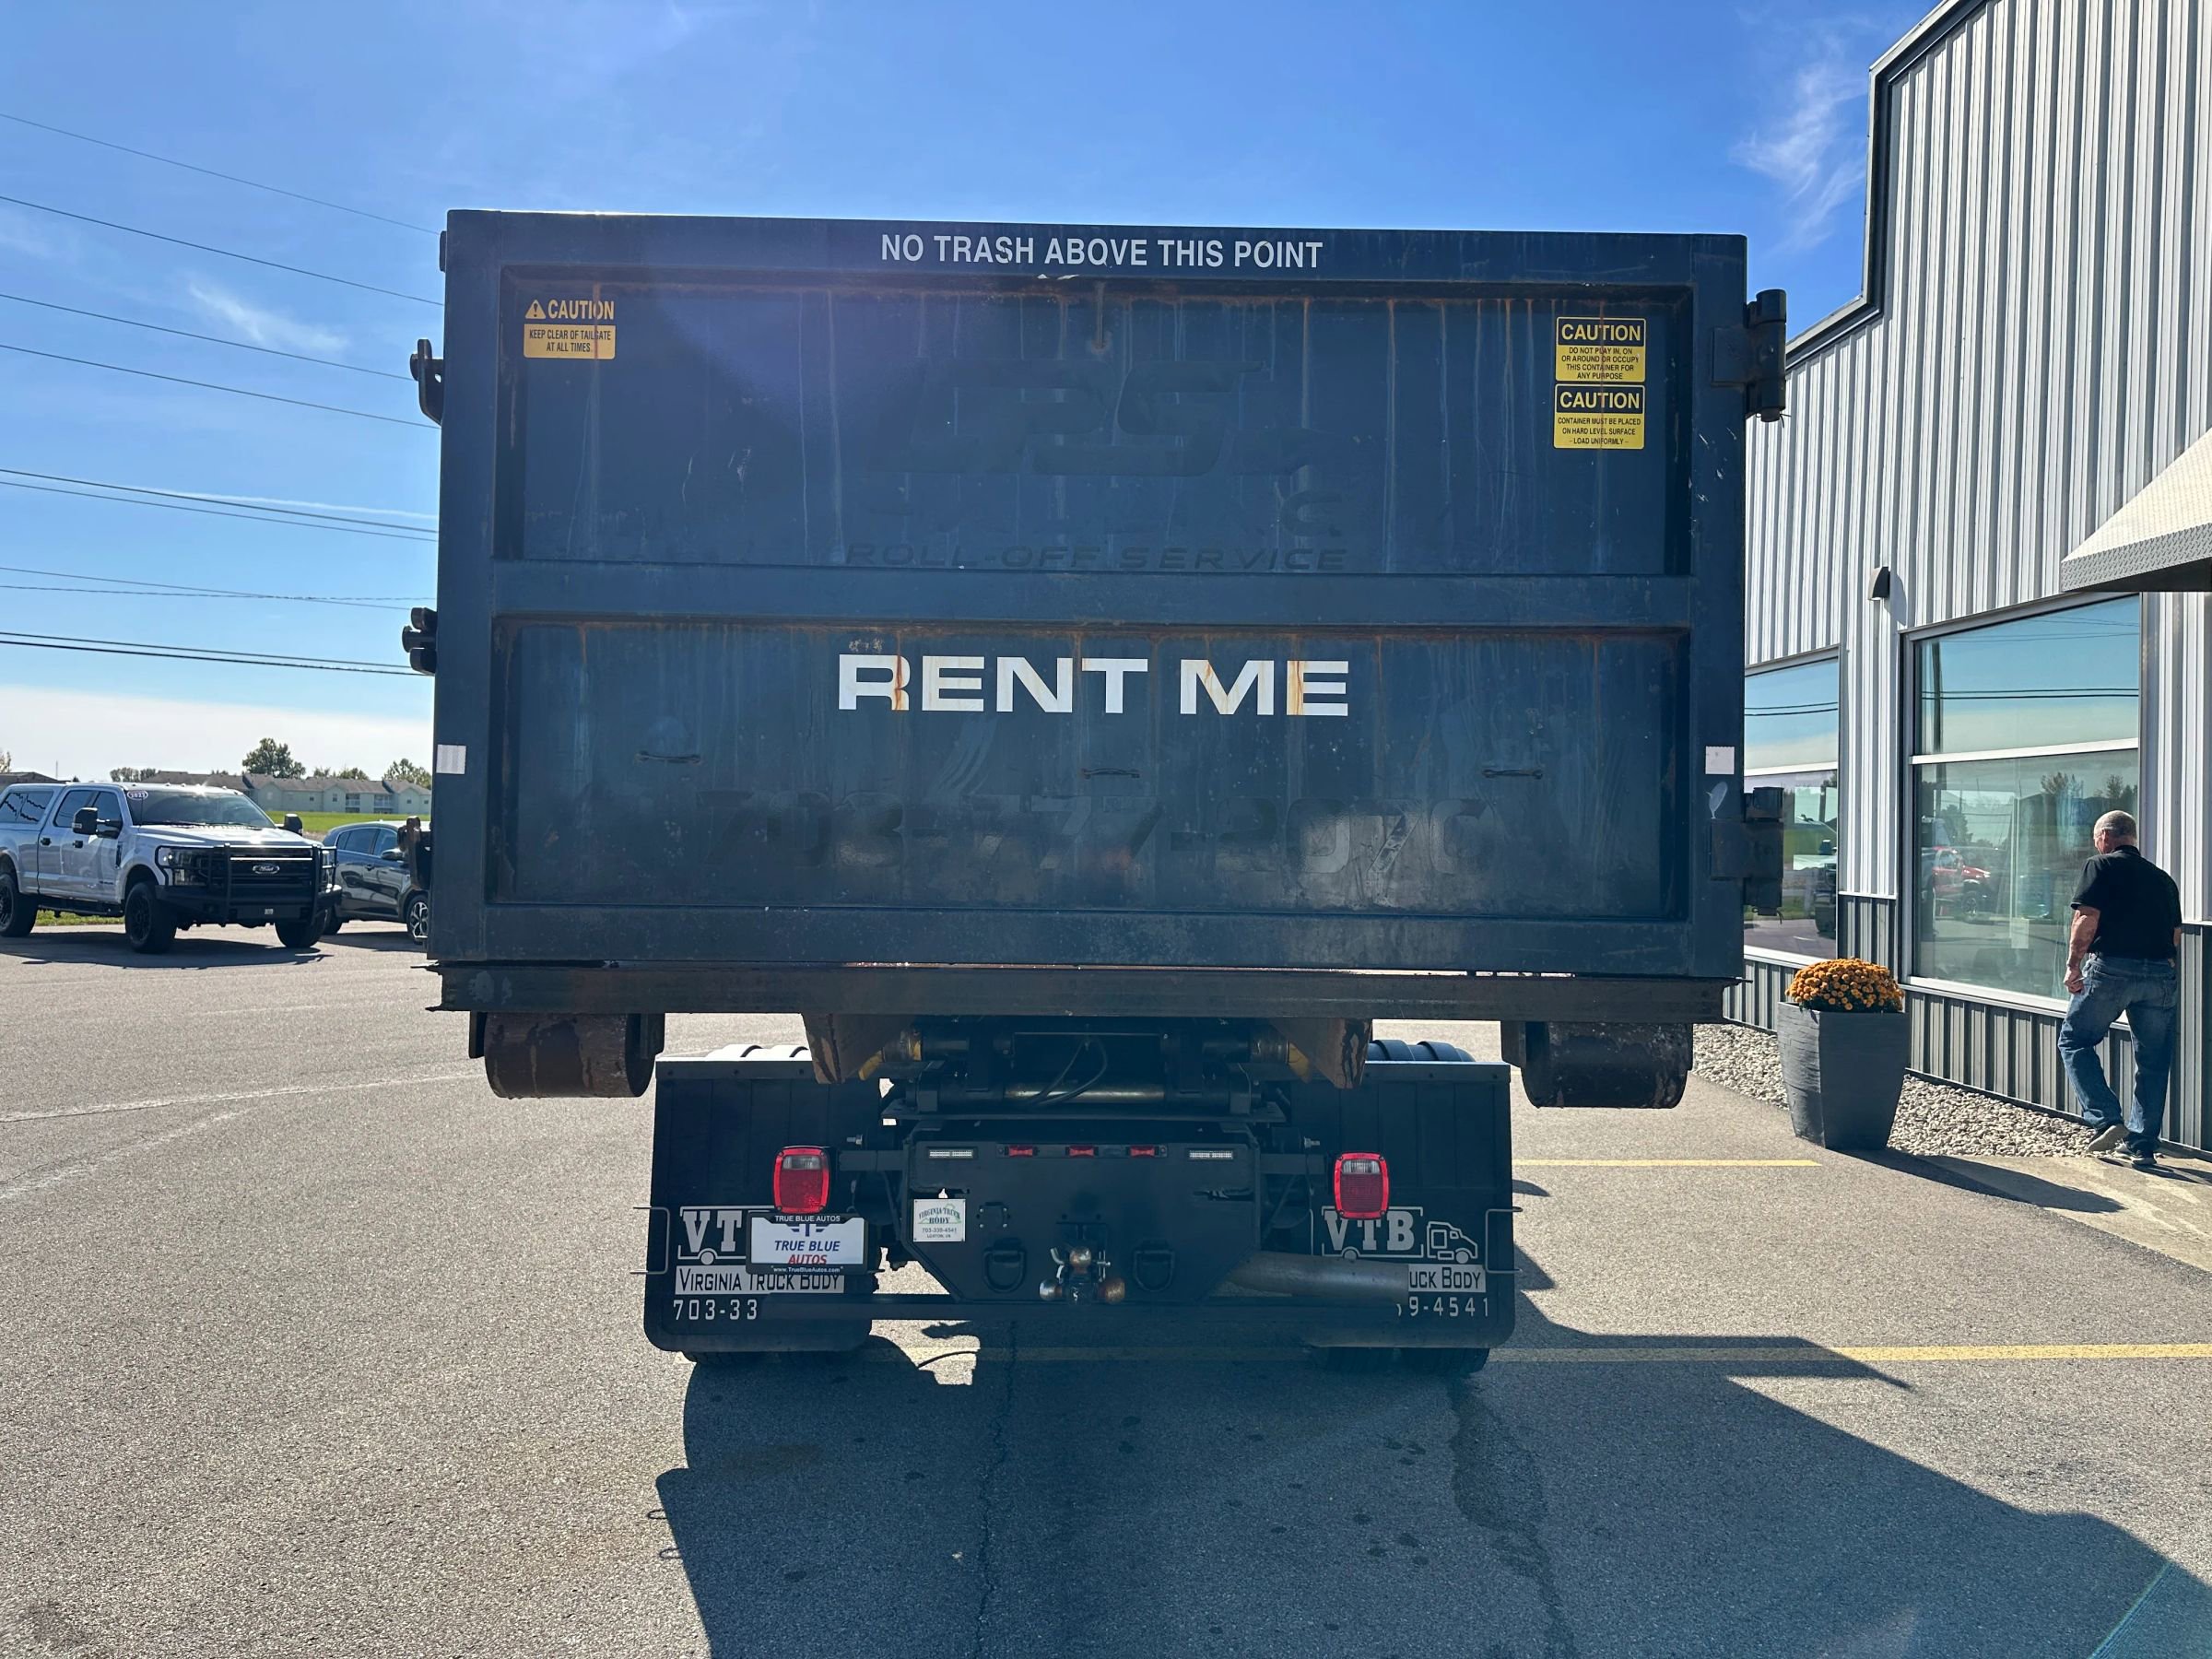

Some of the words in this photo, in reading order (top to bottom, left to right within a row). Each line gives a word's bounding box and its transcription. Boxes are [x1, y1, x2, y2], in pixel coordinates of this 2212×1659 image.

[881, 234, 924, 262] NO
[934, 235, 1034, 265] TRASH
[1044, 237, 1148, 266] ABOVE
[1156, 239, 1224, 267] THIS
[1233, 241, 1324, 269] POINT
[547, 300, 615, 320] CAUTION
[529, 330, 546, 339] KEEP
[547, 330, 569, 340] CLEAR
[570, 331, 580, 340] OF
[581, 331, 611, 340] TAILGATE
[1561, 324, 1641, 341] CAUTION
[546, 342, 555, 351] AT
[556, 342, 569, 352] ALL
[1559, 391, 1640, 409] CAUTION
[1572, 427, 1589, 435] HARD
[1573, 436, 1590, 444] LOAD
[1591, 437, 1624, 445] UNIFORMLY
[845, 542, 1101, 569] ROLL-OFF
[1119, 546, 1347, 571] SERVICE
[838, 653, 1149, 715] RENT
[1180, 659, 1349, 717] ME
[775, 1215, 794, 1223] TRUE
[795, 1215, 815, 1223] BLUE
[816, 1215, 841, 1223] AUTOS
[919, 1208, 942, 1219] VIRGINIA
[1324, 1210, 1415, 1252] VTB
[774, 1240, 806, 1252] TRUE
[808, 1241, 841, 1252] BLUE
[787, 1254, 828, 1265] AUTOS
[679, 1268, 742, 1292] VIRGINIA
[800, 1274, 839, 1291] BODY
[1441, 1266, 1481, 1289] BODY
